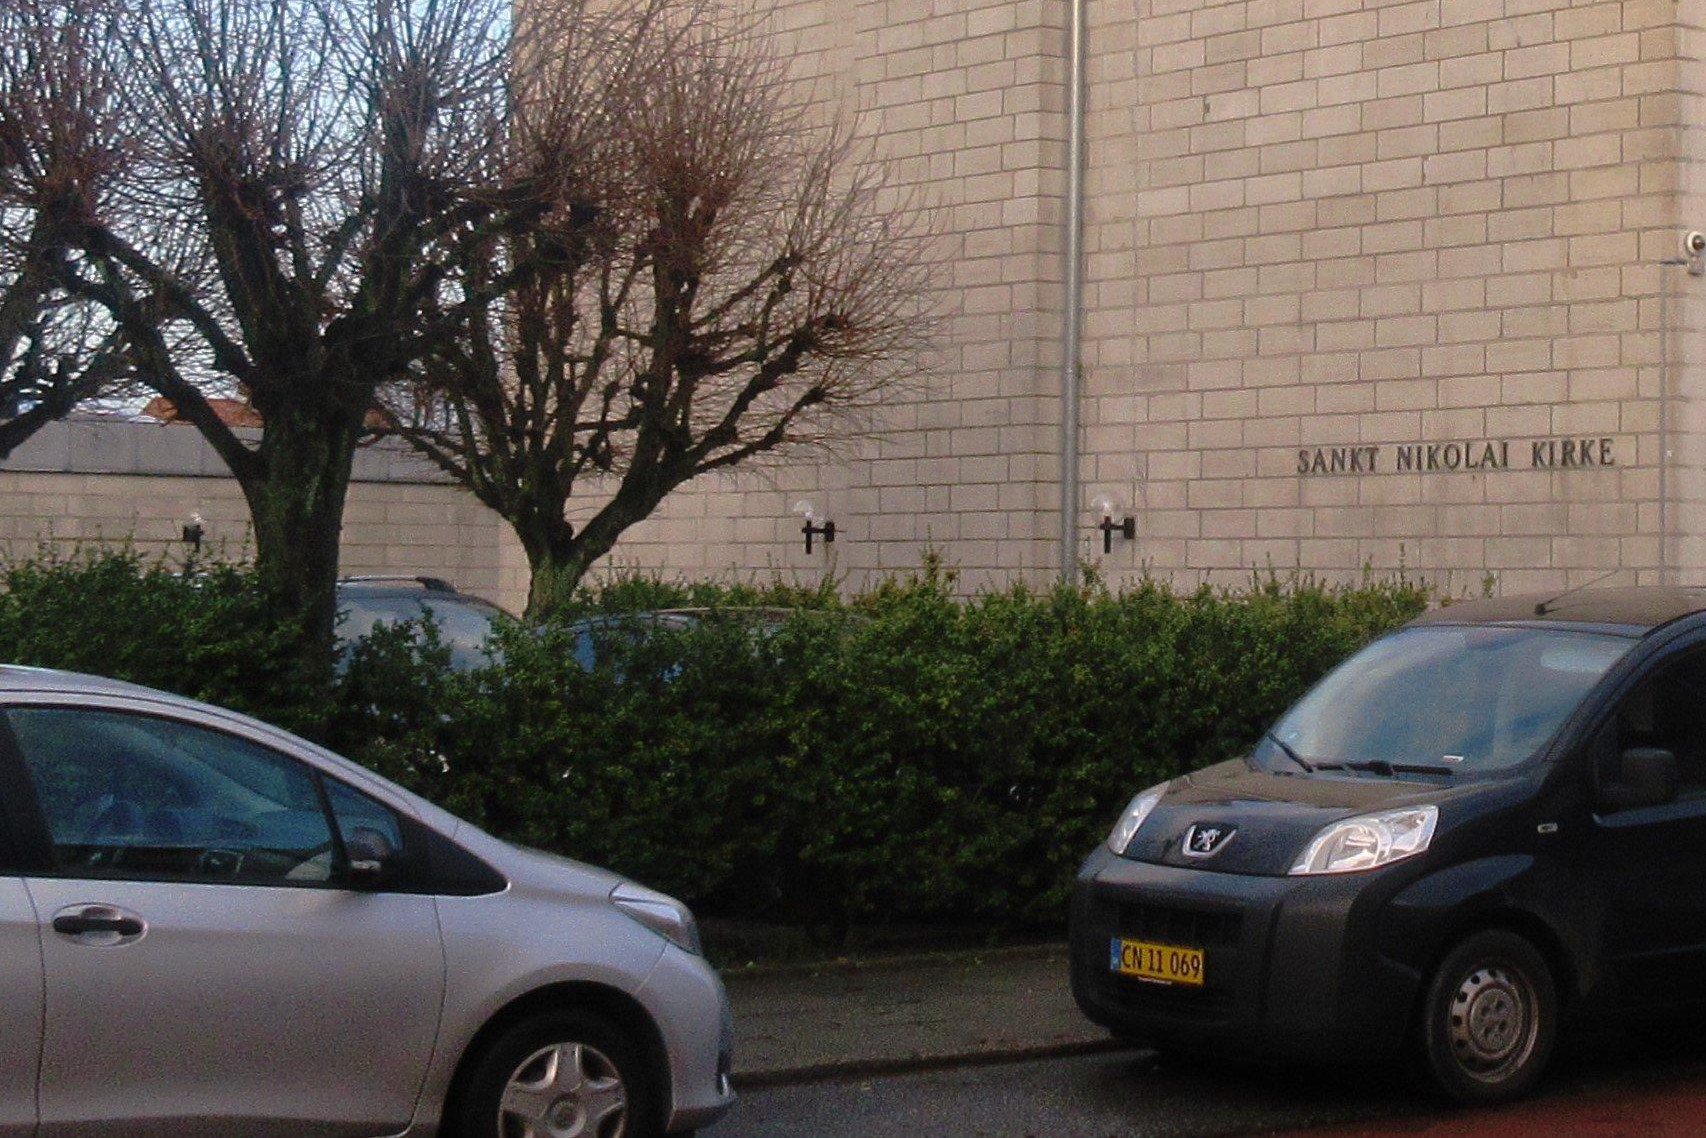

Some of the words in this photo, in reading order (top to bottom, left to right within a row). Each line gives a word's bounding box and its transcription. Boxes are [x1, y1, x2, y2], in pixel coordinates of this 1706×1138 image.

[1297, 446, 1379, 473] SANKT
[1397, 441, 1509, 471] NIKOLAI
[1531, 437, 1615, 467] KIRKE
[1122, 945, 1142, 970] CN
[1149, 948, 1163, 973] 11
[1170, 952, 1200, 978] 069
